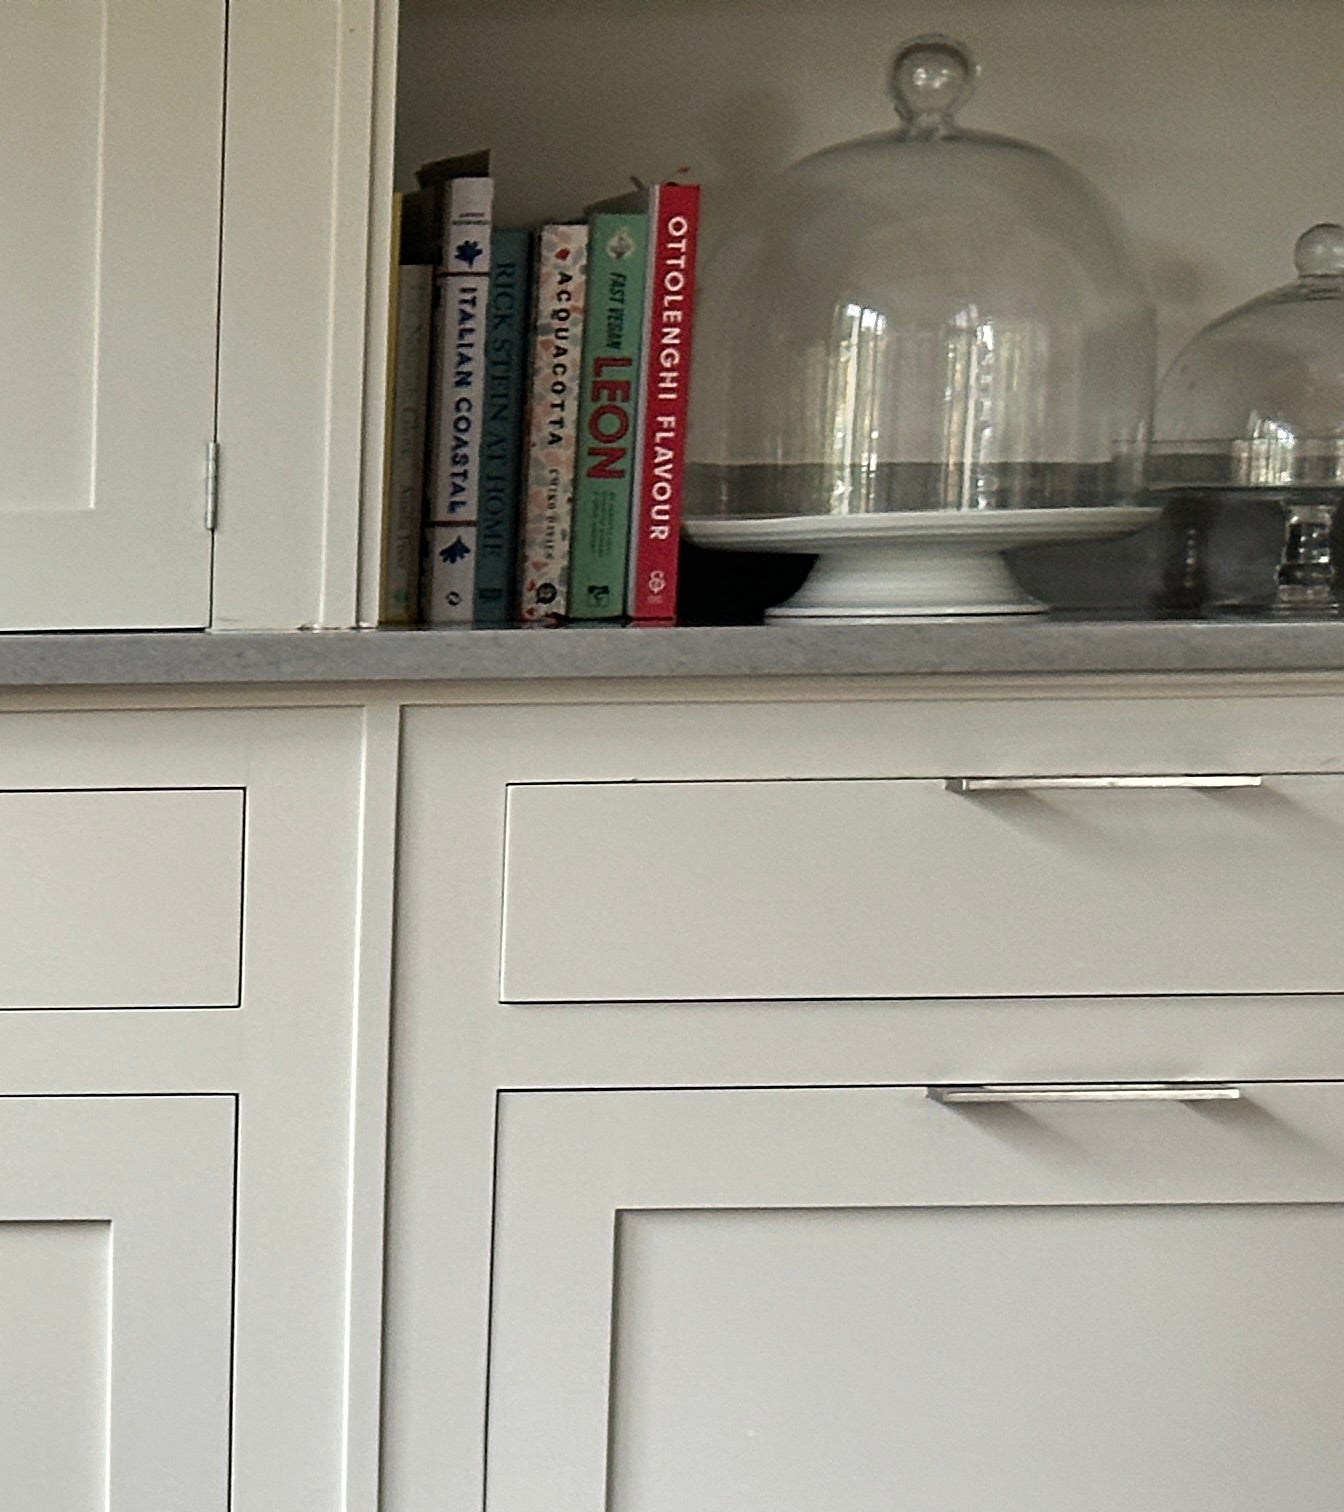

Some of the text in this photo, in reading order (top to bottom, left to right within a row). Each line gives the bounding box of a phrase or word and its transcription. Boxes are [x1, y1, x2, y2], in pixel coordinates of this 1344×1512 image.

[448, 287, 477, 513] ITALIAN COASTAL
[547, 273, 573, 446] ACQUACOTTA
[587, 357, 632, 479] LEON
[650, 216, 688, 540] OTTOLENGHI FLAVOUR
